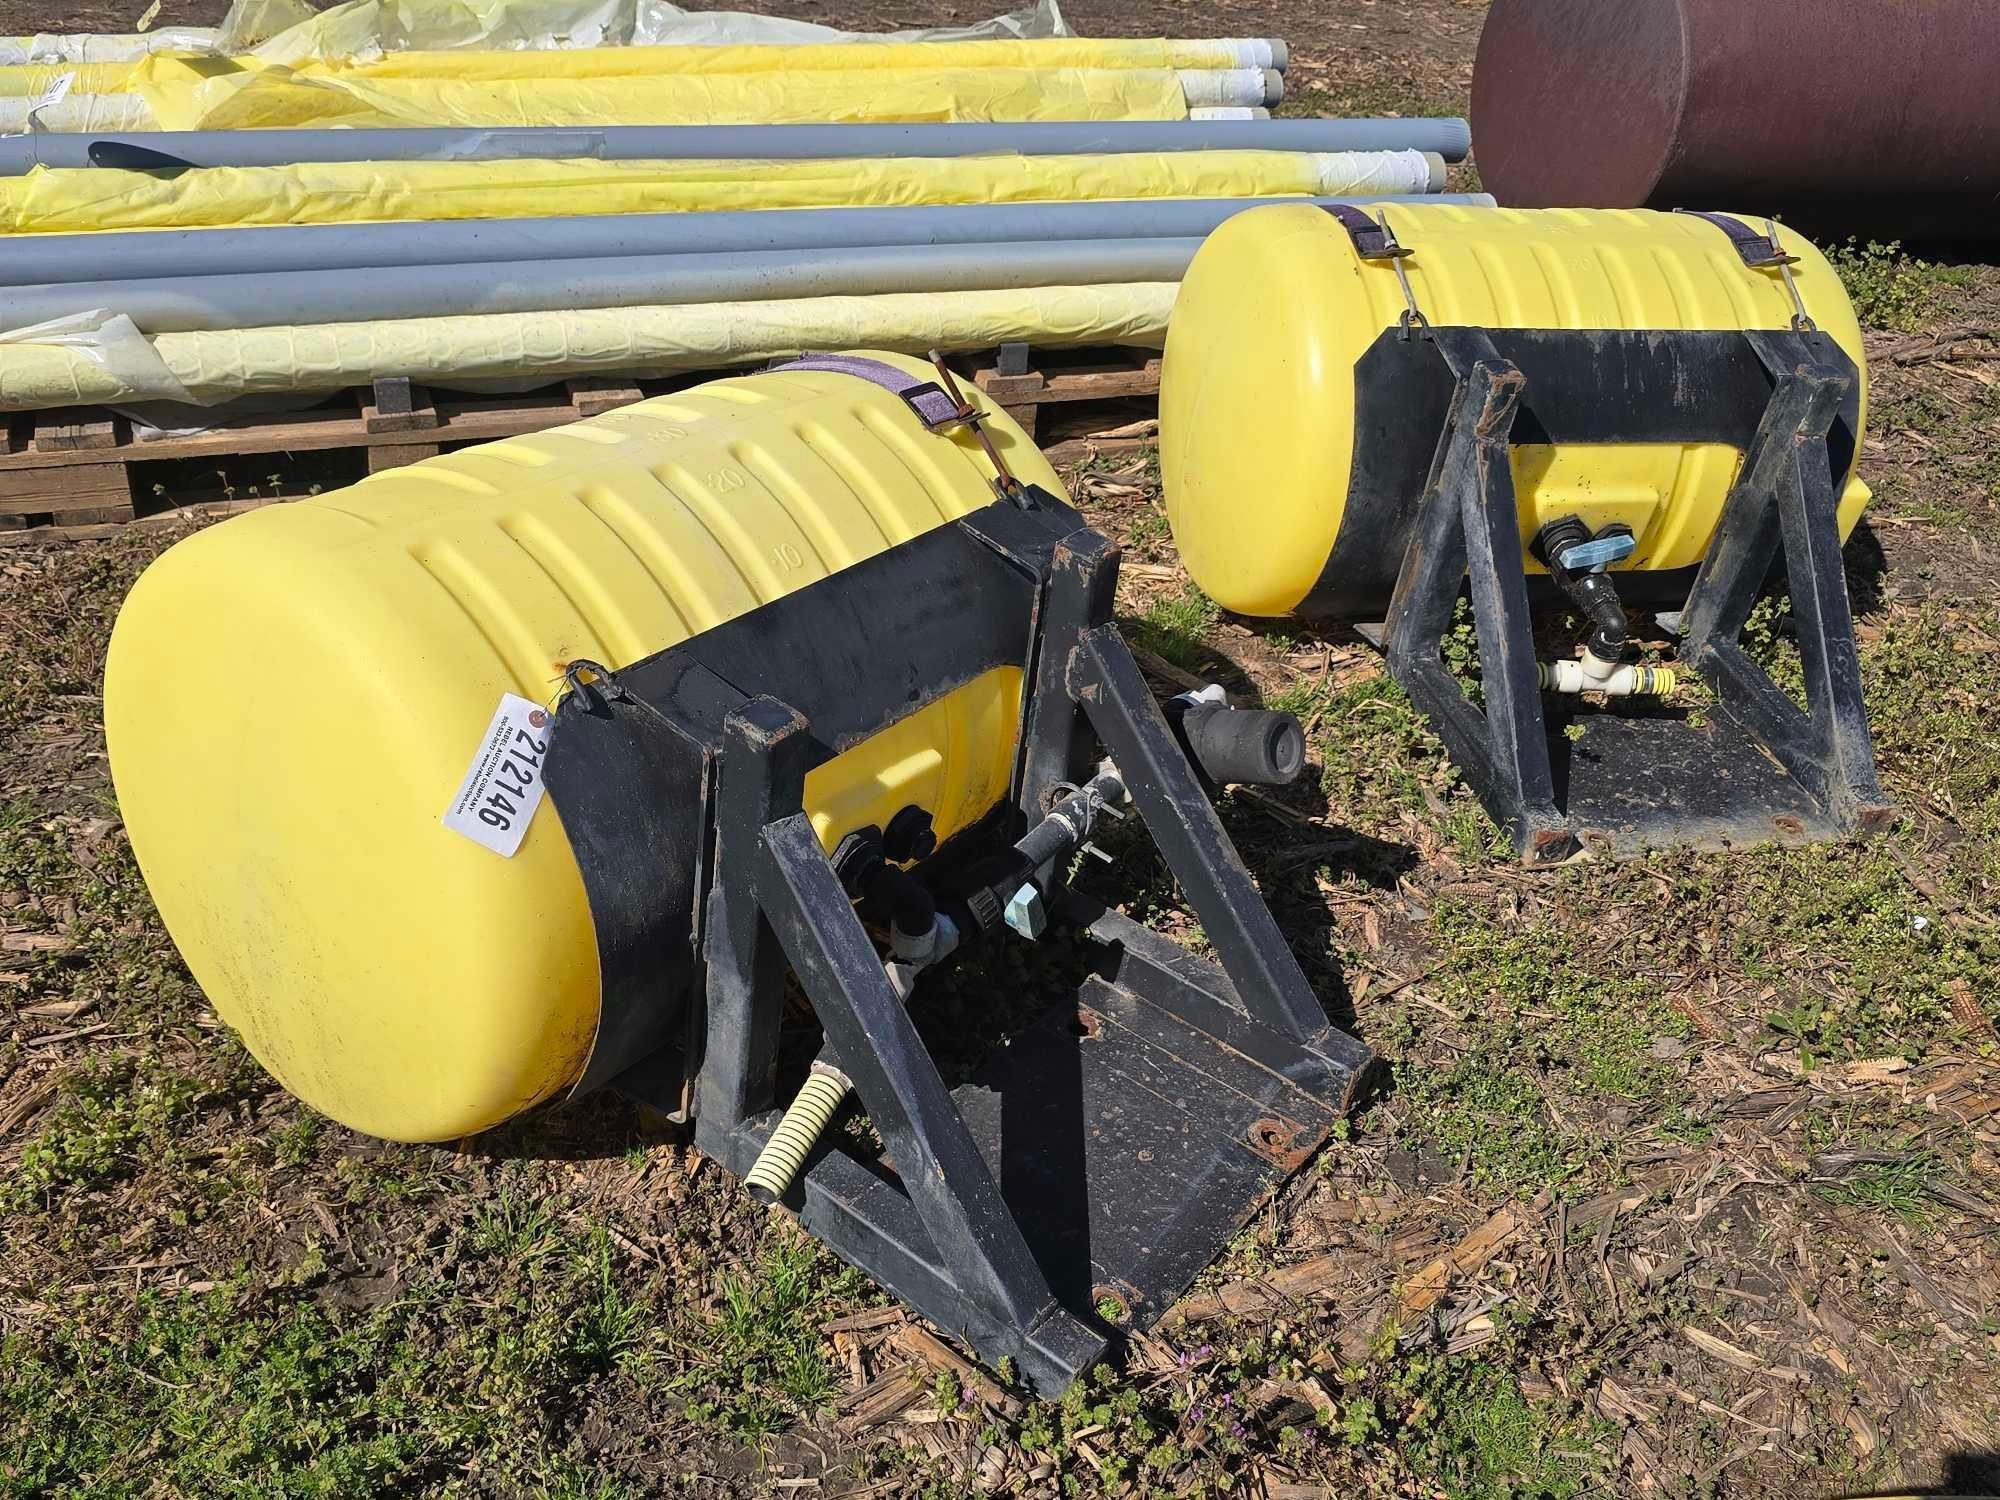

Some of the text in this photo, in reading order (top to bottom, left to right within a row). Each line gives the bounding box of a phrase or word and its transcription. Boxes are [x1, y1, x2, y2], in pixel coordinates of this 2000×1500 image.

[469, 726, 513, 812] REBEL AUCTION COMPANY
[478, 729, 547, 831] 212146
